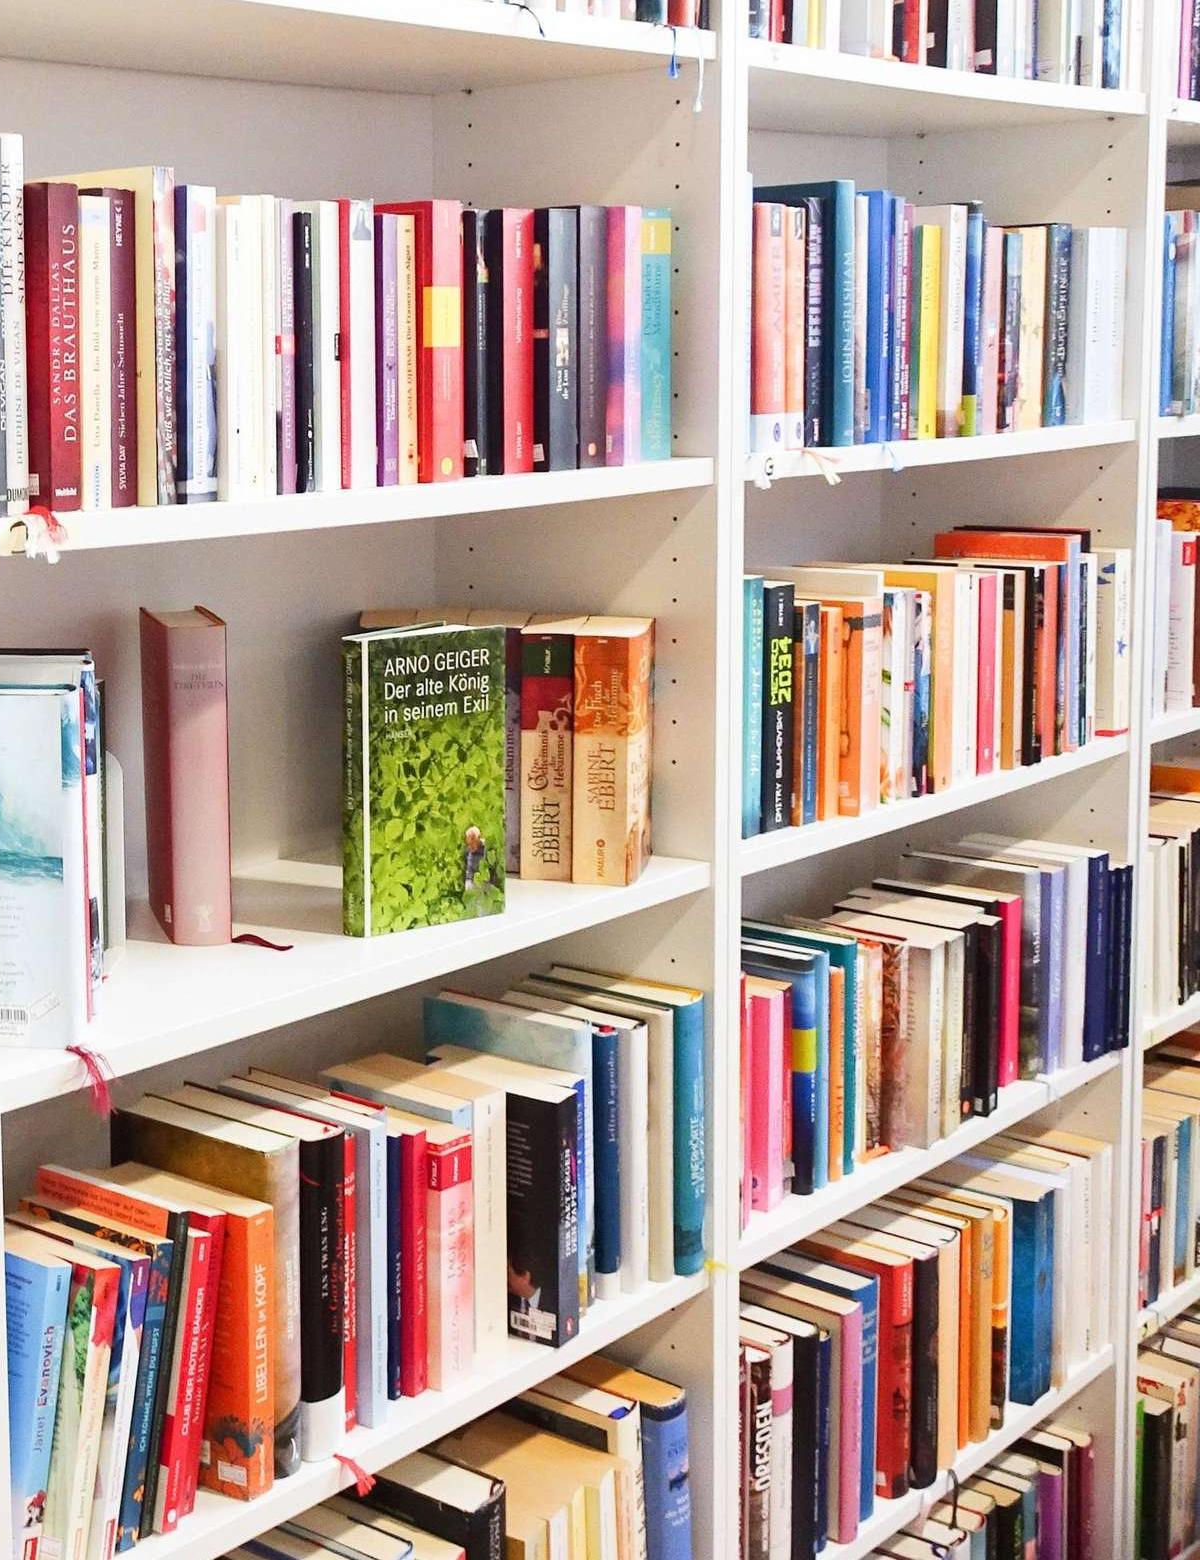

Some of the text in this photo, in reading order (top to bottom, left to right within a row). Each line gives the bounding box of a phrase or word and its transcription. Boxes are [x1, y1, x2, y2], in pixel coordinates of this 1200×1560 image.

[1, 162, 13, 295] DIE KINDER
[115, 214, 123, 247] HEYNE
[51, 262, 61, 404] SANDRA DALLAS
[62, 224, 77, 442] DAS BRAUTHAUS
[842, 338, 851, 383] JOHN
[384, 649, 489, 677] ARNO GEIGER
[385, 672, 489, 699] Der alte König
[770, 638, 778, 706] METRO
[779, 636, 792, 704] 2034
[384, 694, 489, 723] in seinem Exil
[585, 681, 601, 709] Fluch
[386, 730, 415, 739] HANSER
[527, 729, 549, 791] Geheimnis
[554, 734, 565, 788] Hebamme
[588, 750, 599, 804] SABINE
[599, 743, 615, 811] EBERT
[532, 804, 542, 857] SABINE
[543, 798, 560, 864] EBERT
[320, 1207, 329, 1298] TAN TWAN ENG
[254, 1263, 267, 1307] KOPF
[186, 1336, 199, 1376] ROTEN
[255, 1324, 268, 1402] LIBELLEN
[34, 1326, 55, 1453] Janet Evanovich
[184, 1379, 195, 1402] DER
[181, 1404, 193, 1436] CLUB
[755, 1400, 772, 1491] DRESDEN
